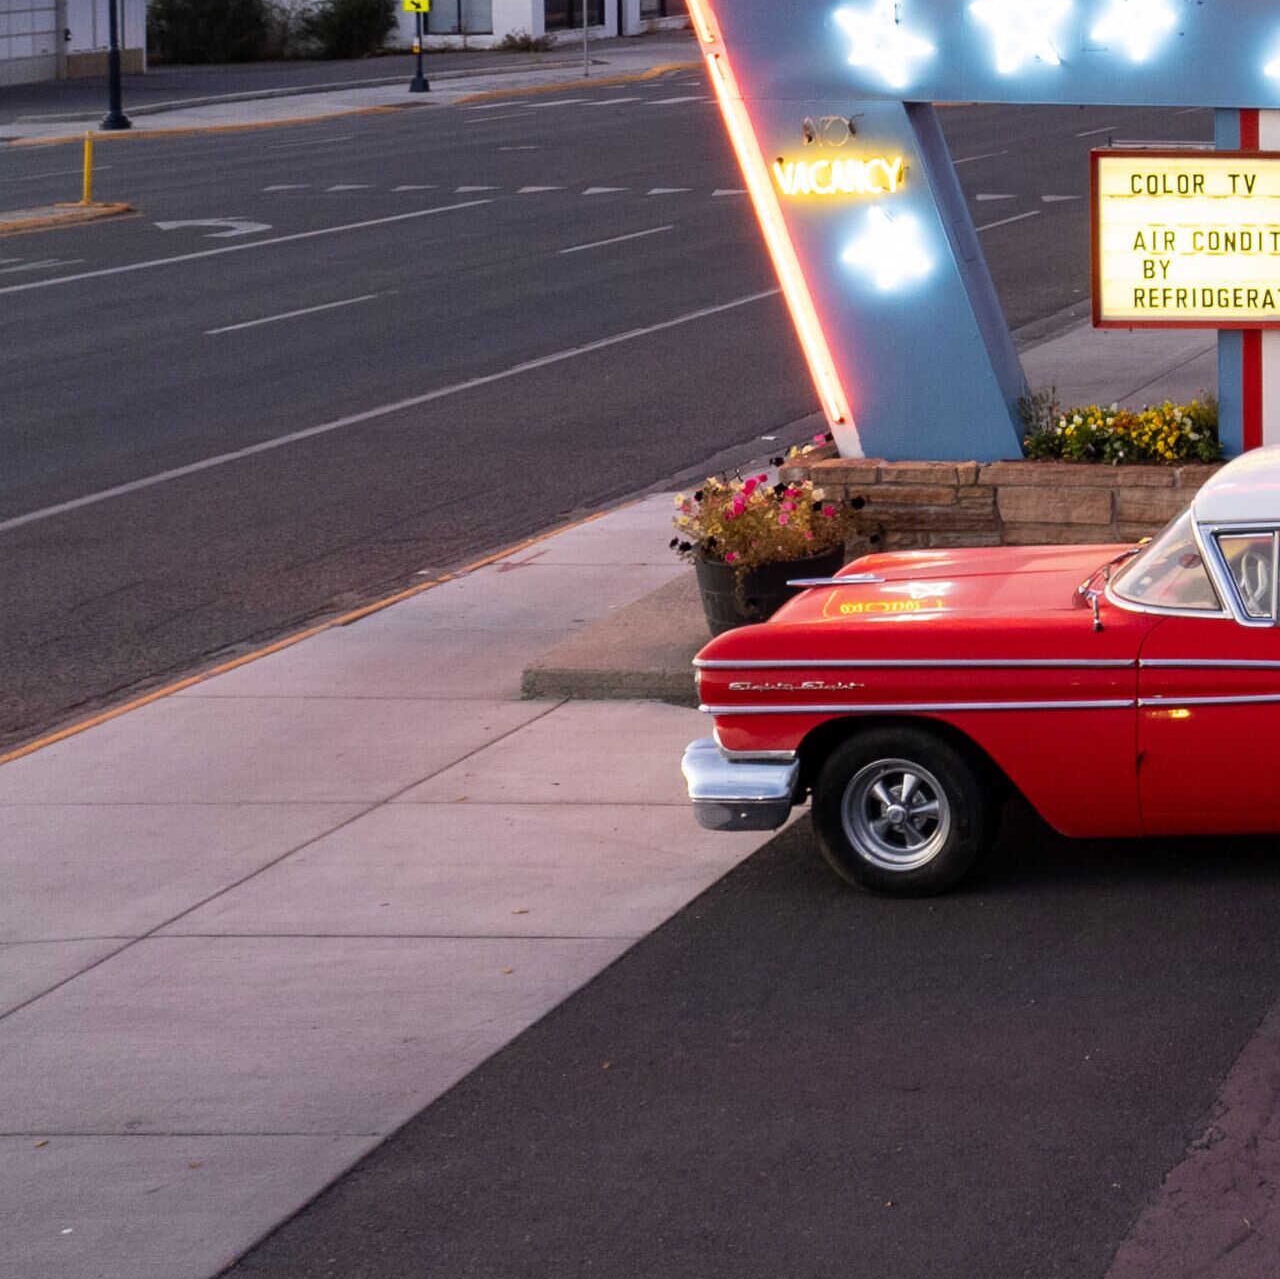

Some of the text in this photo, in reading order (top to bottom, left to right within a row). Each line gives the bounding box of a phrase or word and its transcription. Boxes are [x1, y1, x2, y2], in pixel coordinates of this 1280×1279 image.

[803, 116, 851, 147] NO
[773, 156, 902, 195] VACANCY
[1130, 174, 1257, 194] COLOR TV
[1133, 231, 1176, 251] AIR
[1143, 260, 1171, 279] BY
